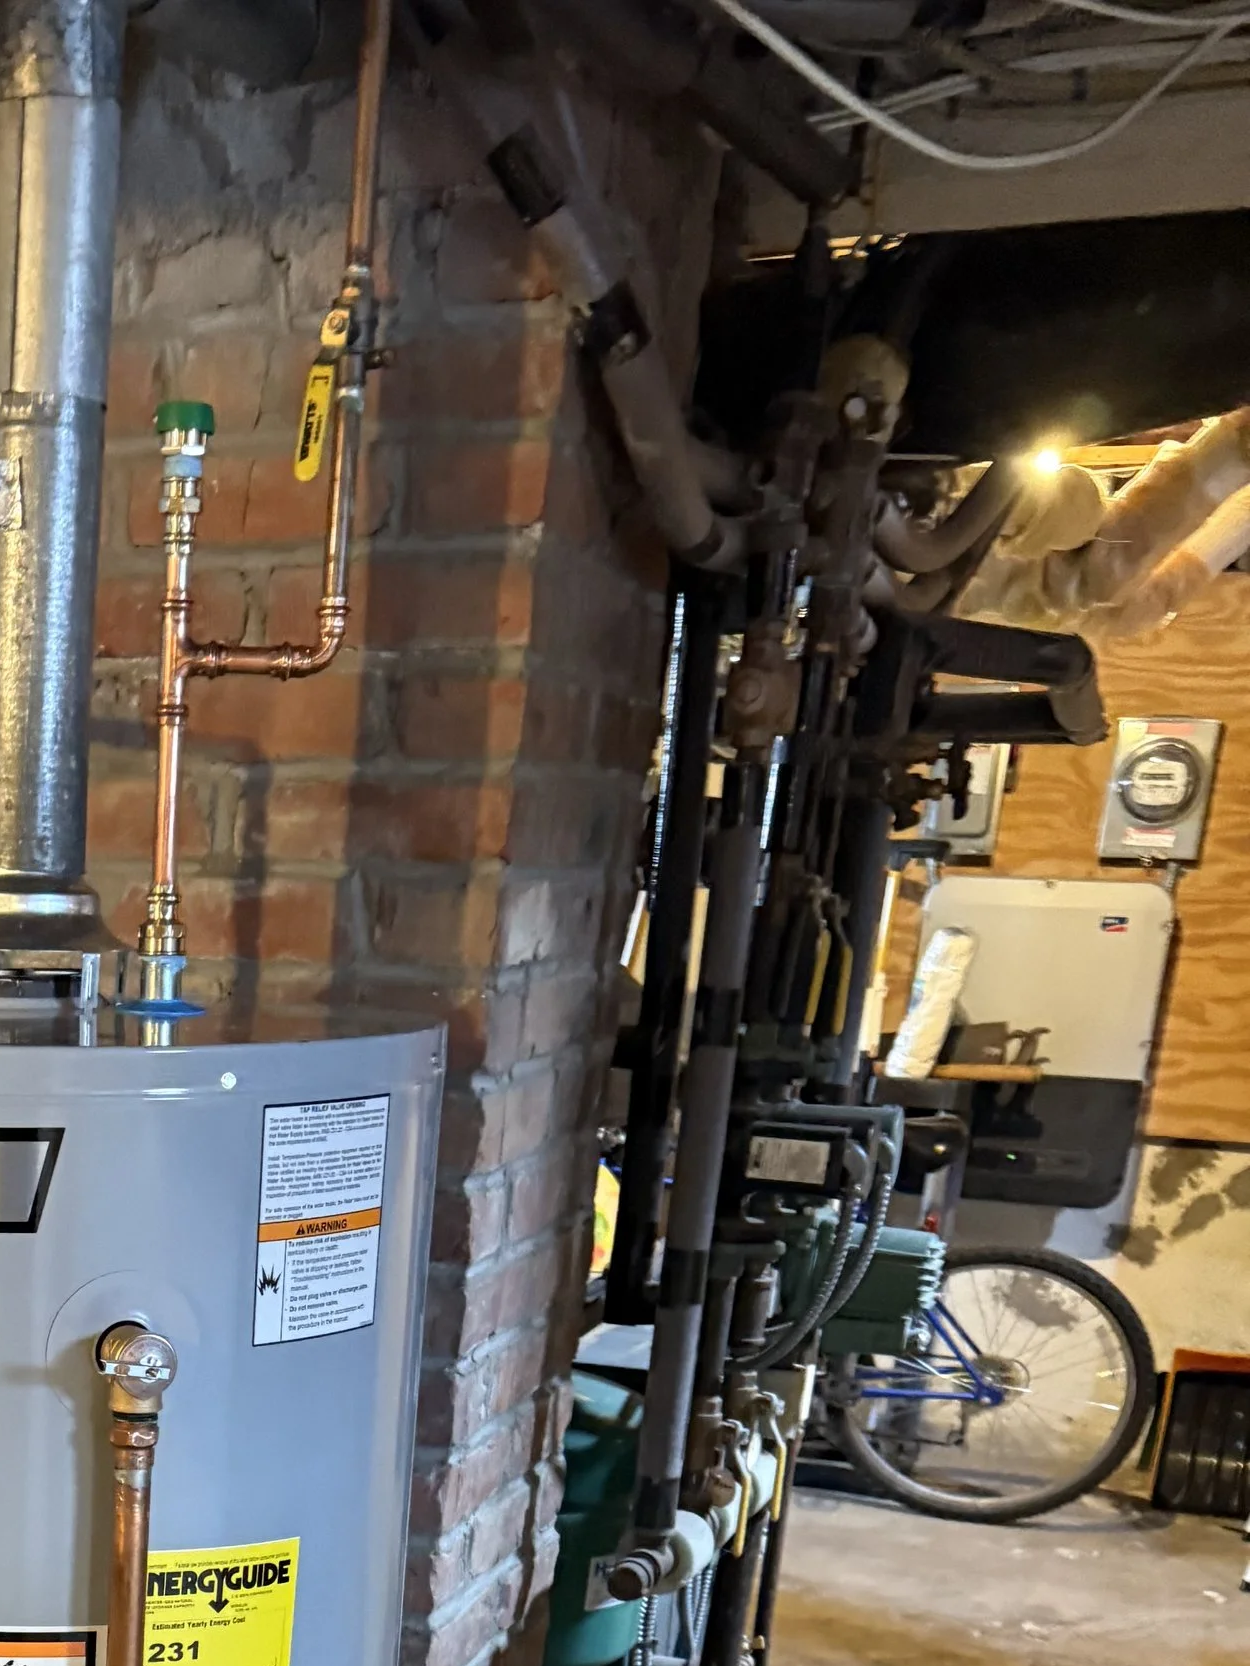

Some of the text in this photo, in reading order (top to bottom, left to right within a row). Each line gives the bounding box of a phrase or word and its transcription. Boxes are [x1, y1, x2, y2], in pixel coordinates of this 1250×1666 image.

[306, 1219, 348, 1234] WARNING
[147, 1559, 291, 1604] NERGYGUIDE
[152, 1619, 184, 1631] Estimated
[188, 1618, 207, 1629] Yearly
[210, 1618, 230, 1627] Energy
[148, 1641, 199, 1663] 231
